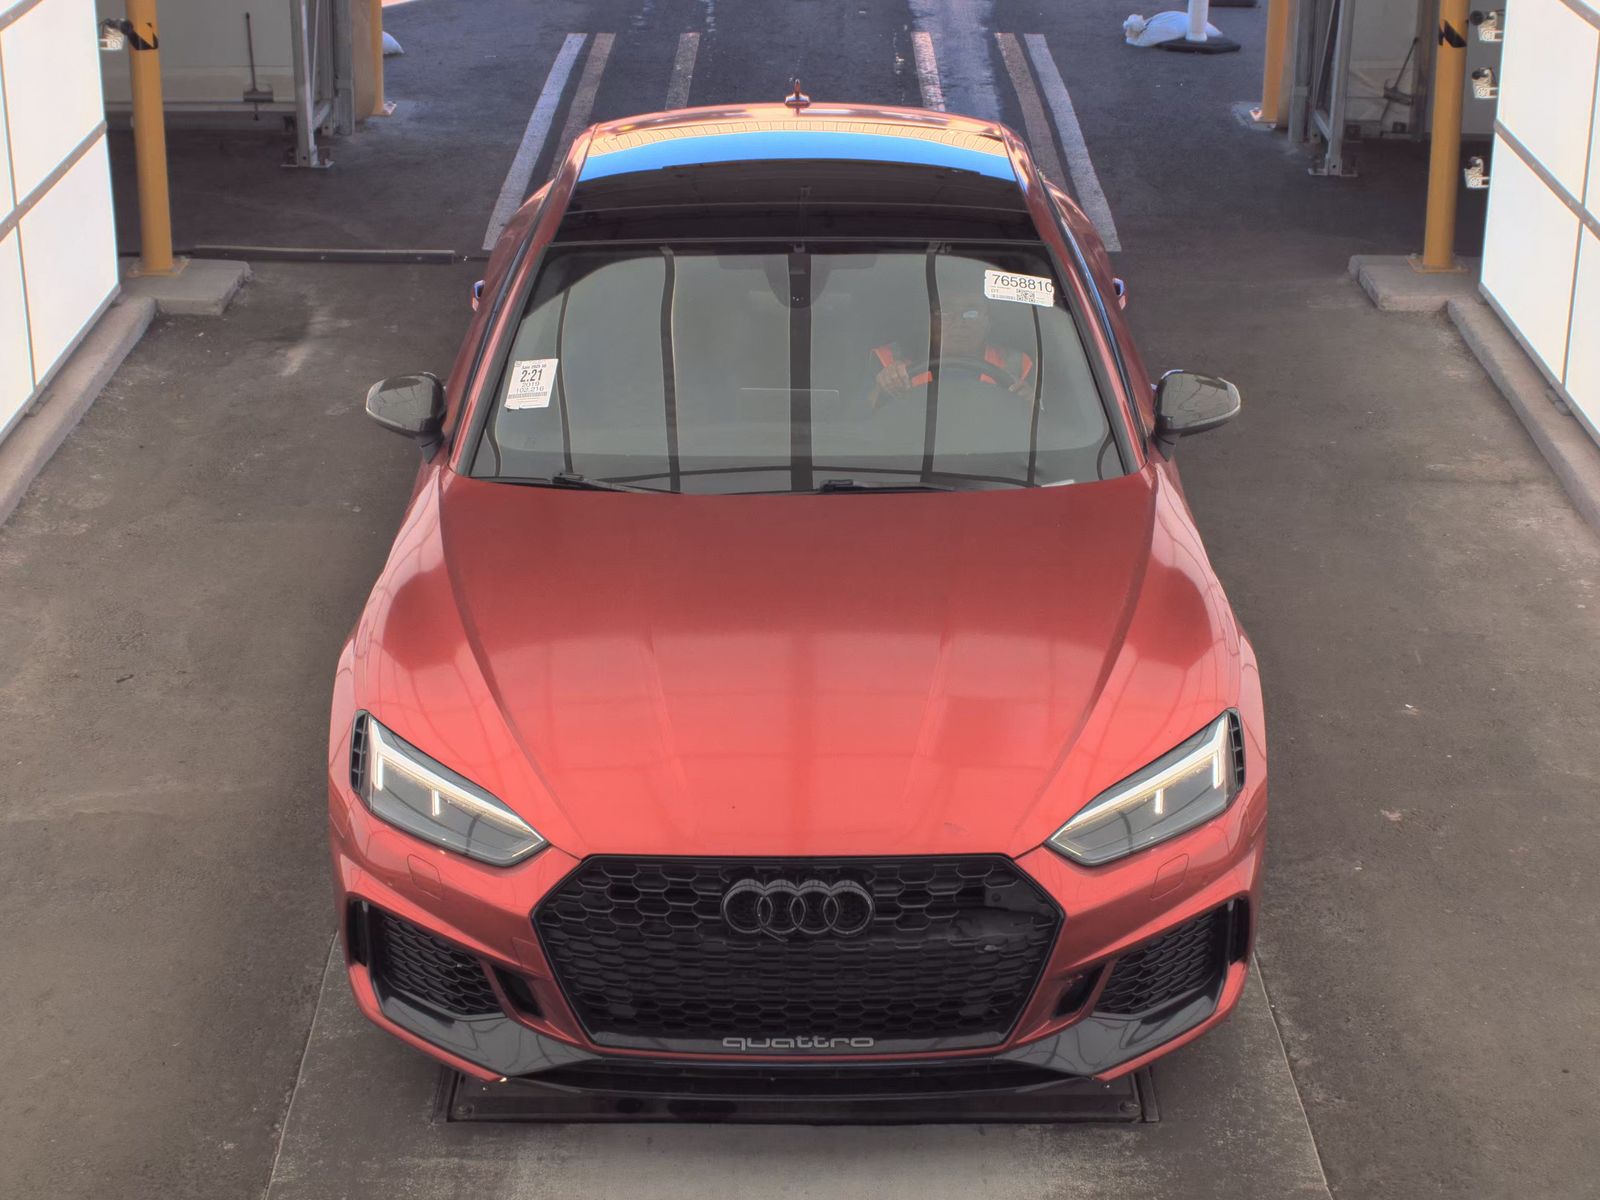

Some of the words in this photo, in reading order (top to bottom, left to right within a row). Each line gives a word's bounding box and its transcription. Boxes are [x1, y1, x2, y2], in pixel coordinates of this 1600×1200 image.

[992, 274, 1052, 292] 7658810
[520, 369, 543, 382] 2:21
[722, 1035, 874, 1051] quattro
